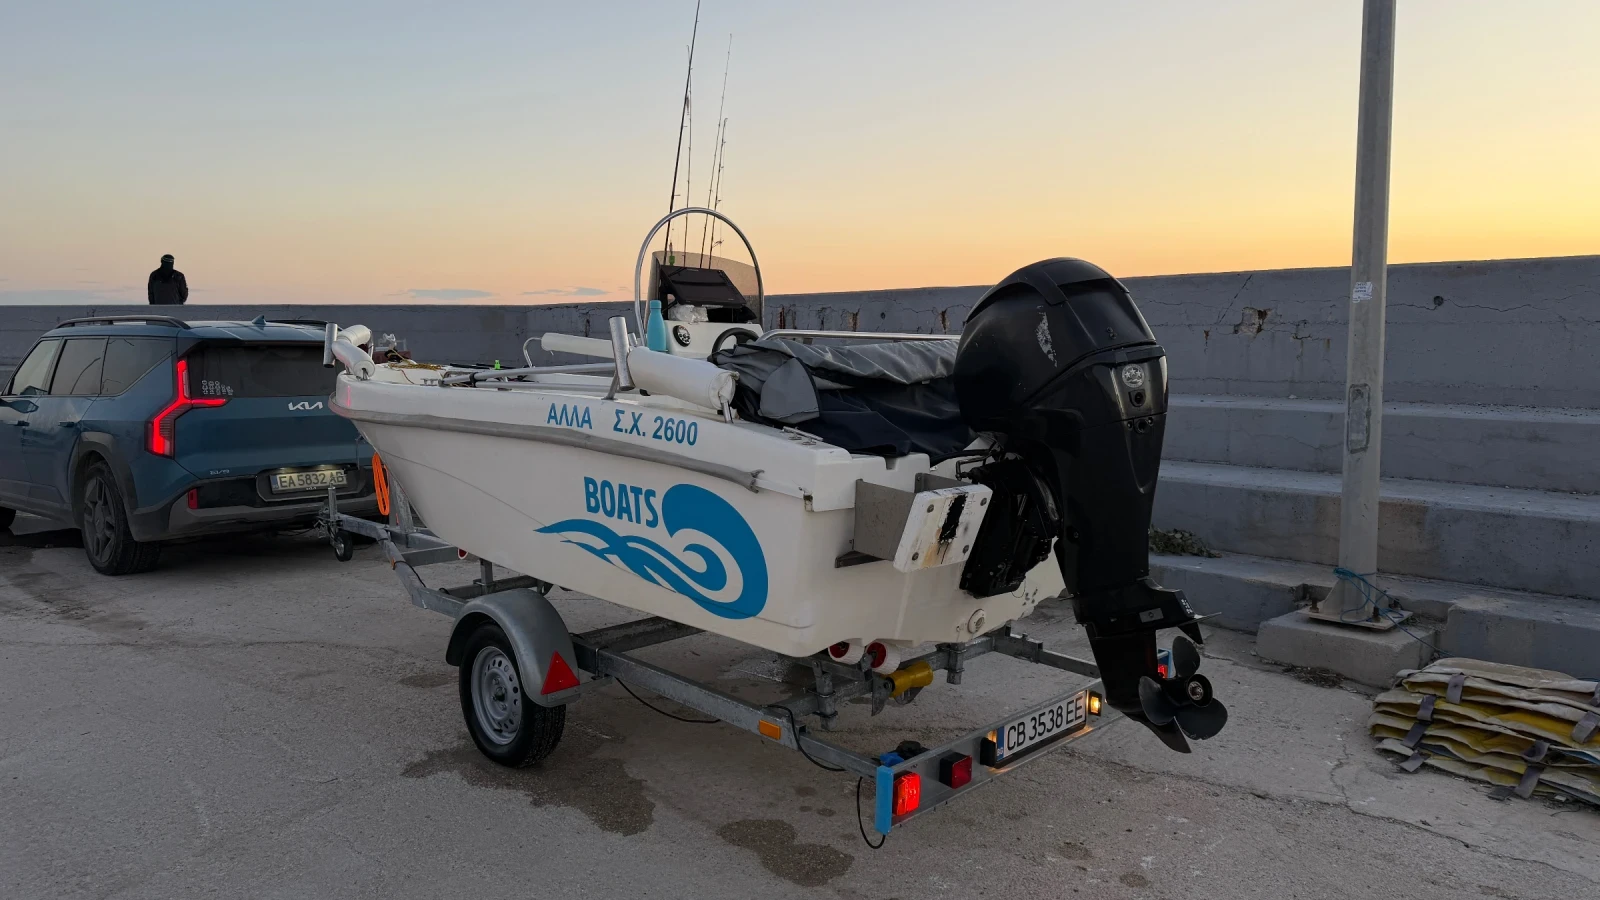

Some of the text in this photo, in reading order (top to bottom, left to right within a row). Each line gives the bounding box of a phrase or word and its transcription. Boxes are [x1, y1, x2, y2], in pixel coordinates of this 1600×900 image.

[288, 401, 323, 410] KIA
[652, 415, 698, 446] 2600
[278, 471, 345, 488] EA 5832 AB
[583, 476, 659, 528] BOATS
[1007, 696, 1083, 751] CB 3538 EE
